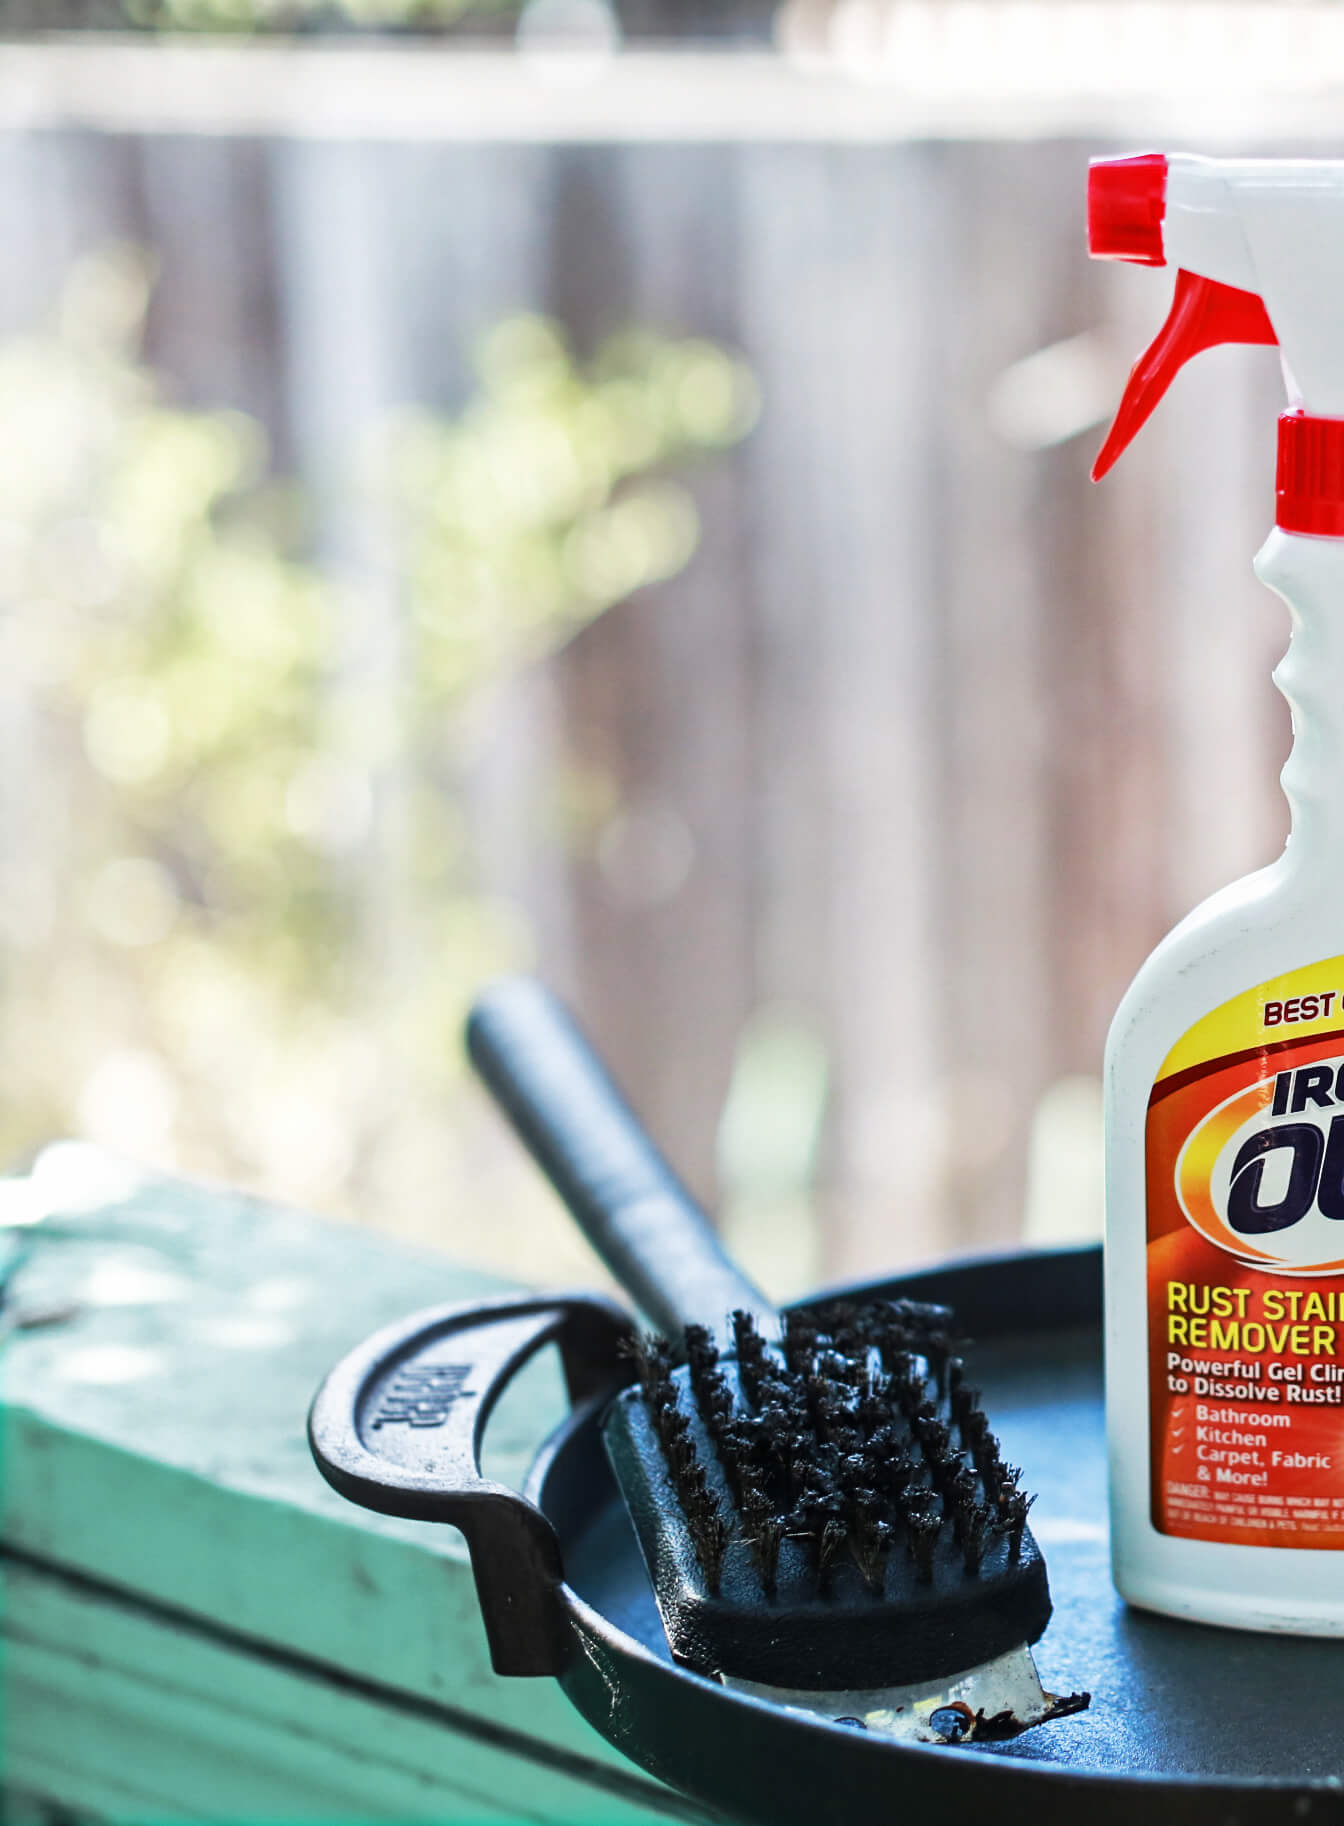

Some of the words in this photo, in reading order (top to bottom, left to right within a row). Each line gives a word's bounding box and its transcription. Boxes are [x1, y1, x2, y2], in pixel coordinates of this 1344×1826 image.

[1263, 992, 1336, 1027] BEST
[1167, 1281, 1251, 1318] RUST
[1168, 1315, 1336, 1355] REMOVER
[1166, 1352, 1261, 1379] Powerful
[1267, 1362, 1303, 1381] Gel
[1167, 1374, 1188, 1393] to
[1193, 1377, 1281, 1402] Dissolve
[1286, 1384, 1342, 1404] Rust!
[1196, 1404, 1291, 1428] Bathroom
[1196, 1426, 1267, 1447] Kitchen
[1271, 1451, 1332, 1469] Fabric
[1197, 1465, 1211, 1481] &
[1215, 1467, 1268, 1487] More!
